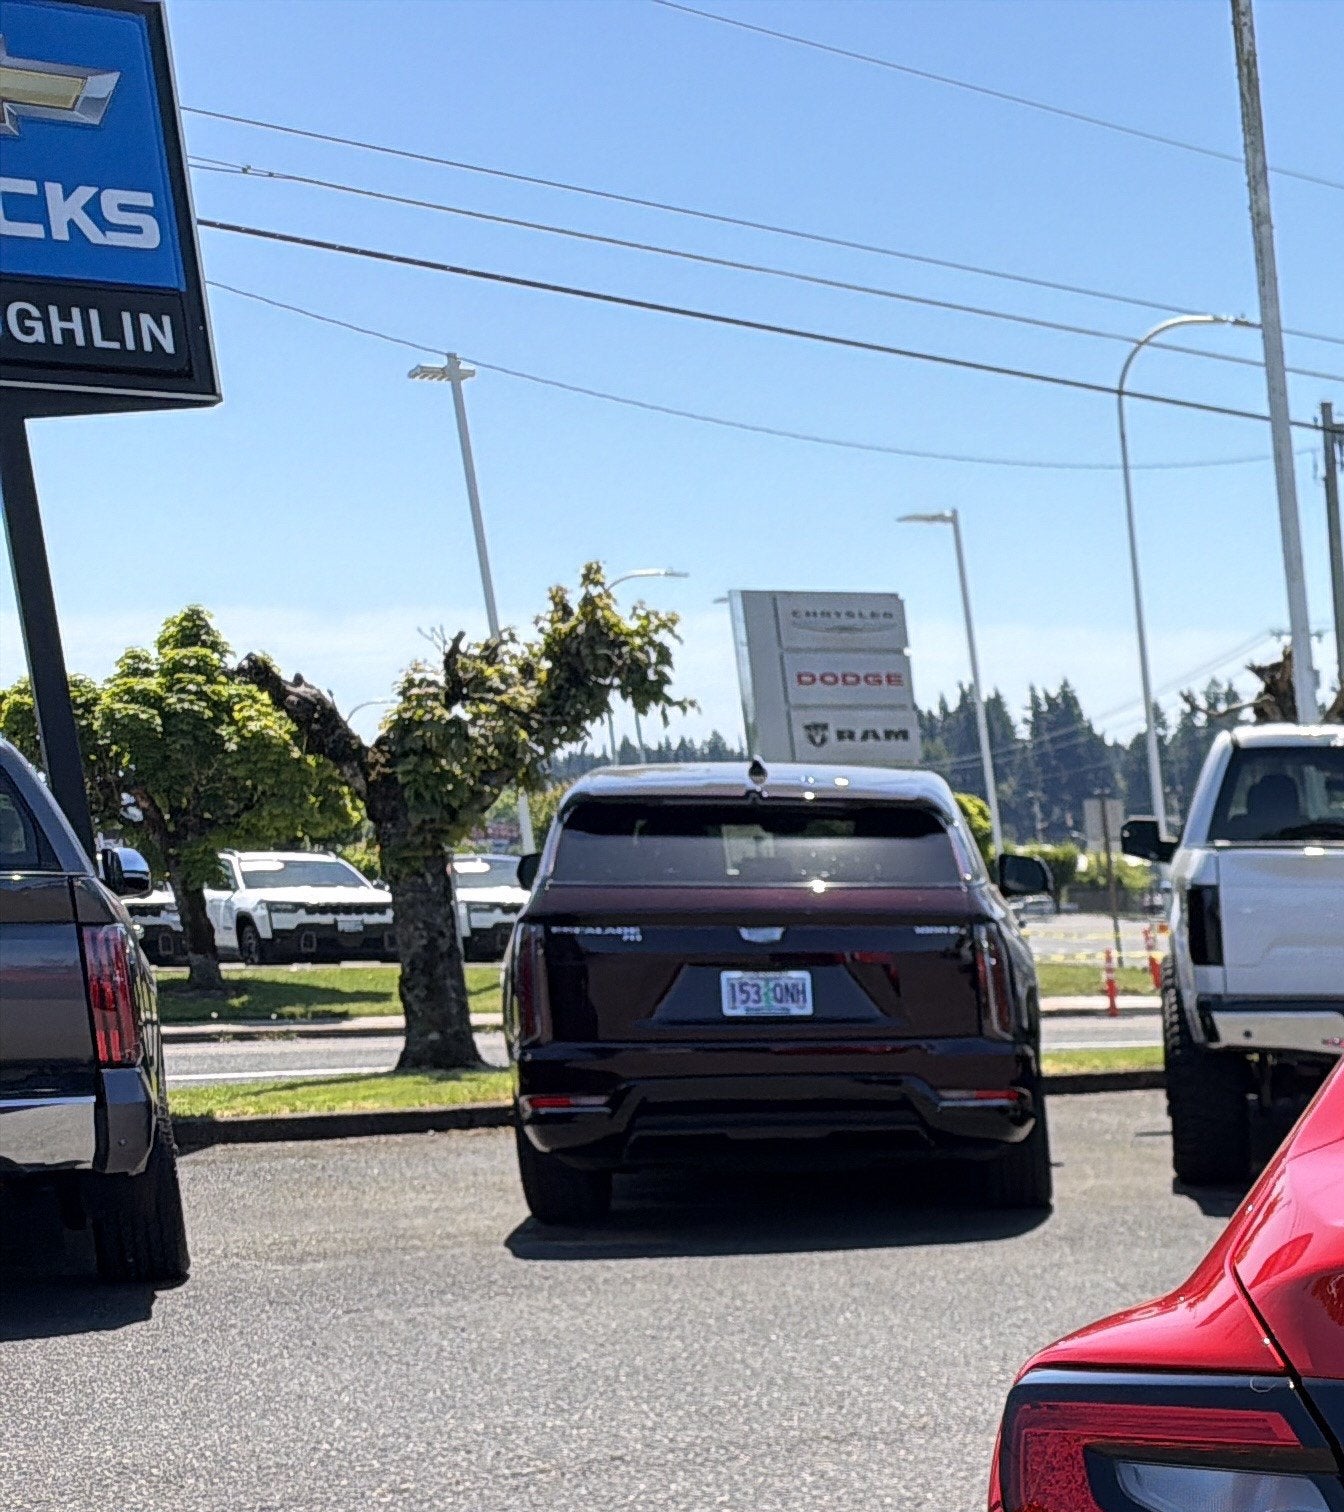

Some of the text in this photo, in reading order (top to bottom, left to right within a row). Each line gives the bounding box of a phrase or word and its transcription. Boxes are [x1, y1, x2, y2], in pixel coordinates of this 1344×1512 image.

[0, 301, 176, 355] GHLIN
[796, 671, 904, 687] DODGE
[836, 728, 909, 742] RAM
